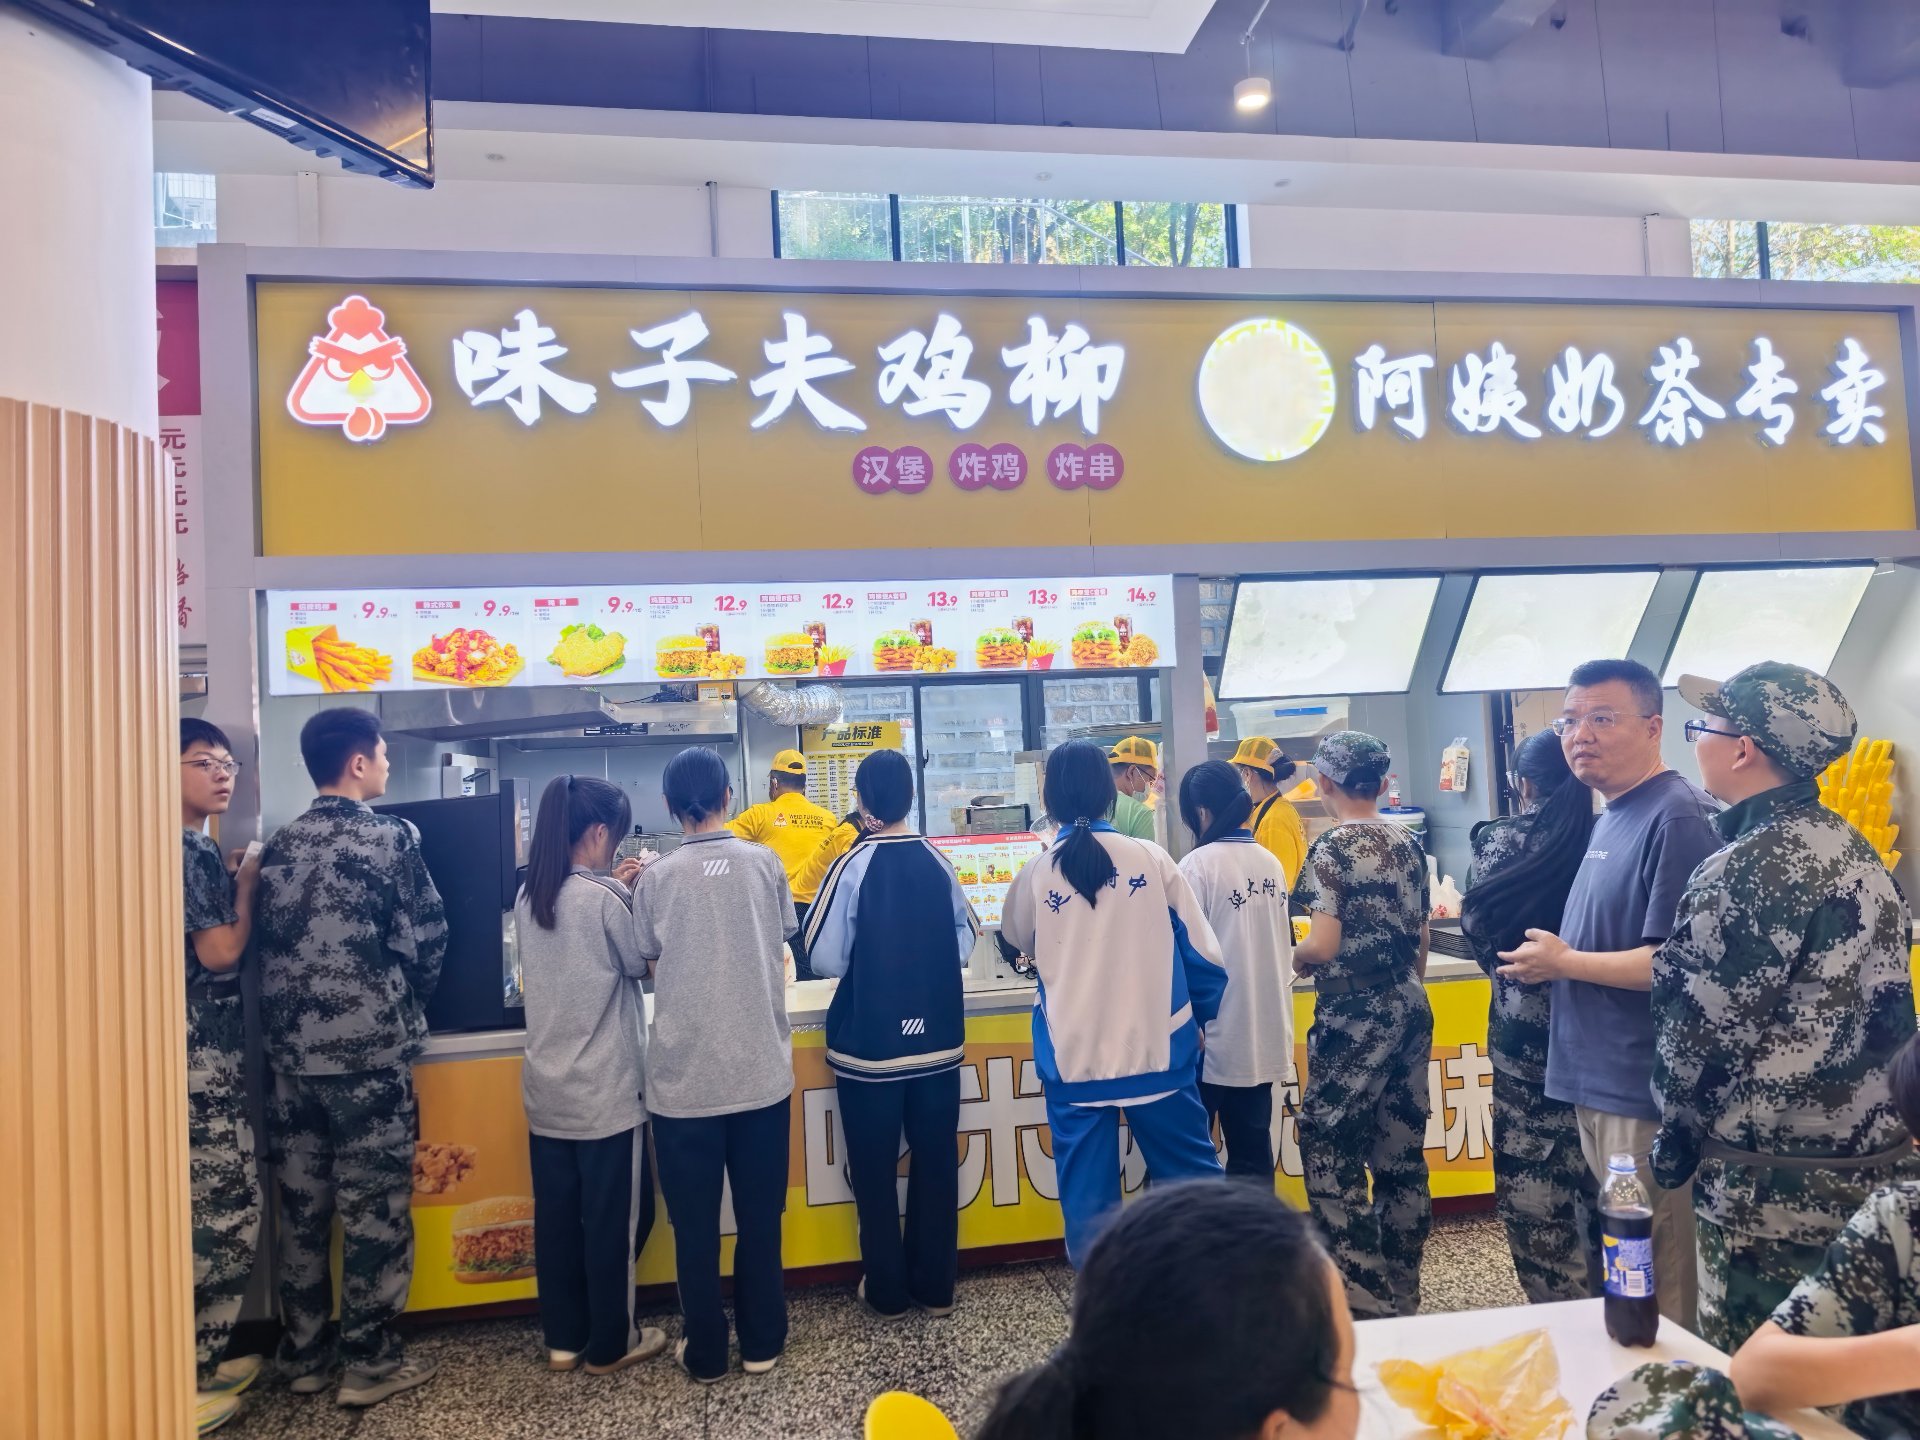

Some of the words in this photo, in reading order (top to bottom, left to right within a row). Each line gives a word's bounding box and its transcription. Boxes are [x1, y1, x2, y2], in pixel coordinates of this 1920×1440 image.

[452, 307, 1127, 434] 味子夫鸡柳
[1355, 337, 1888, 446] 阿姨奶茶专卖
[860, 455, 926, 485] 汉堡
[957, 452, 1021, 482] 炸鸡
[1055, 452, 1116, 482] 炸串
[821, 725, 883, 741] 产品标准
